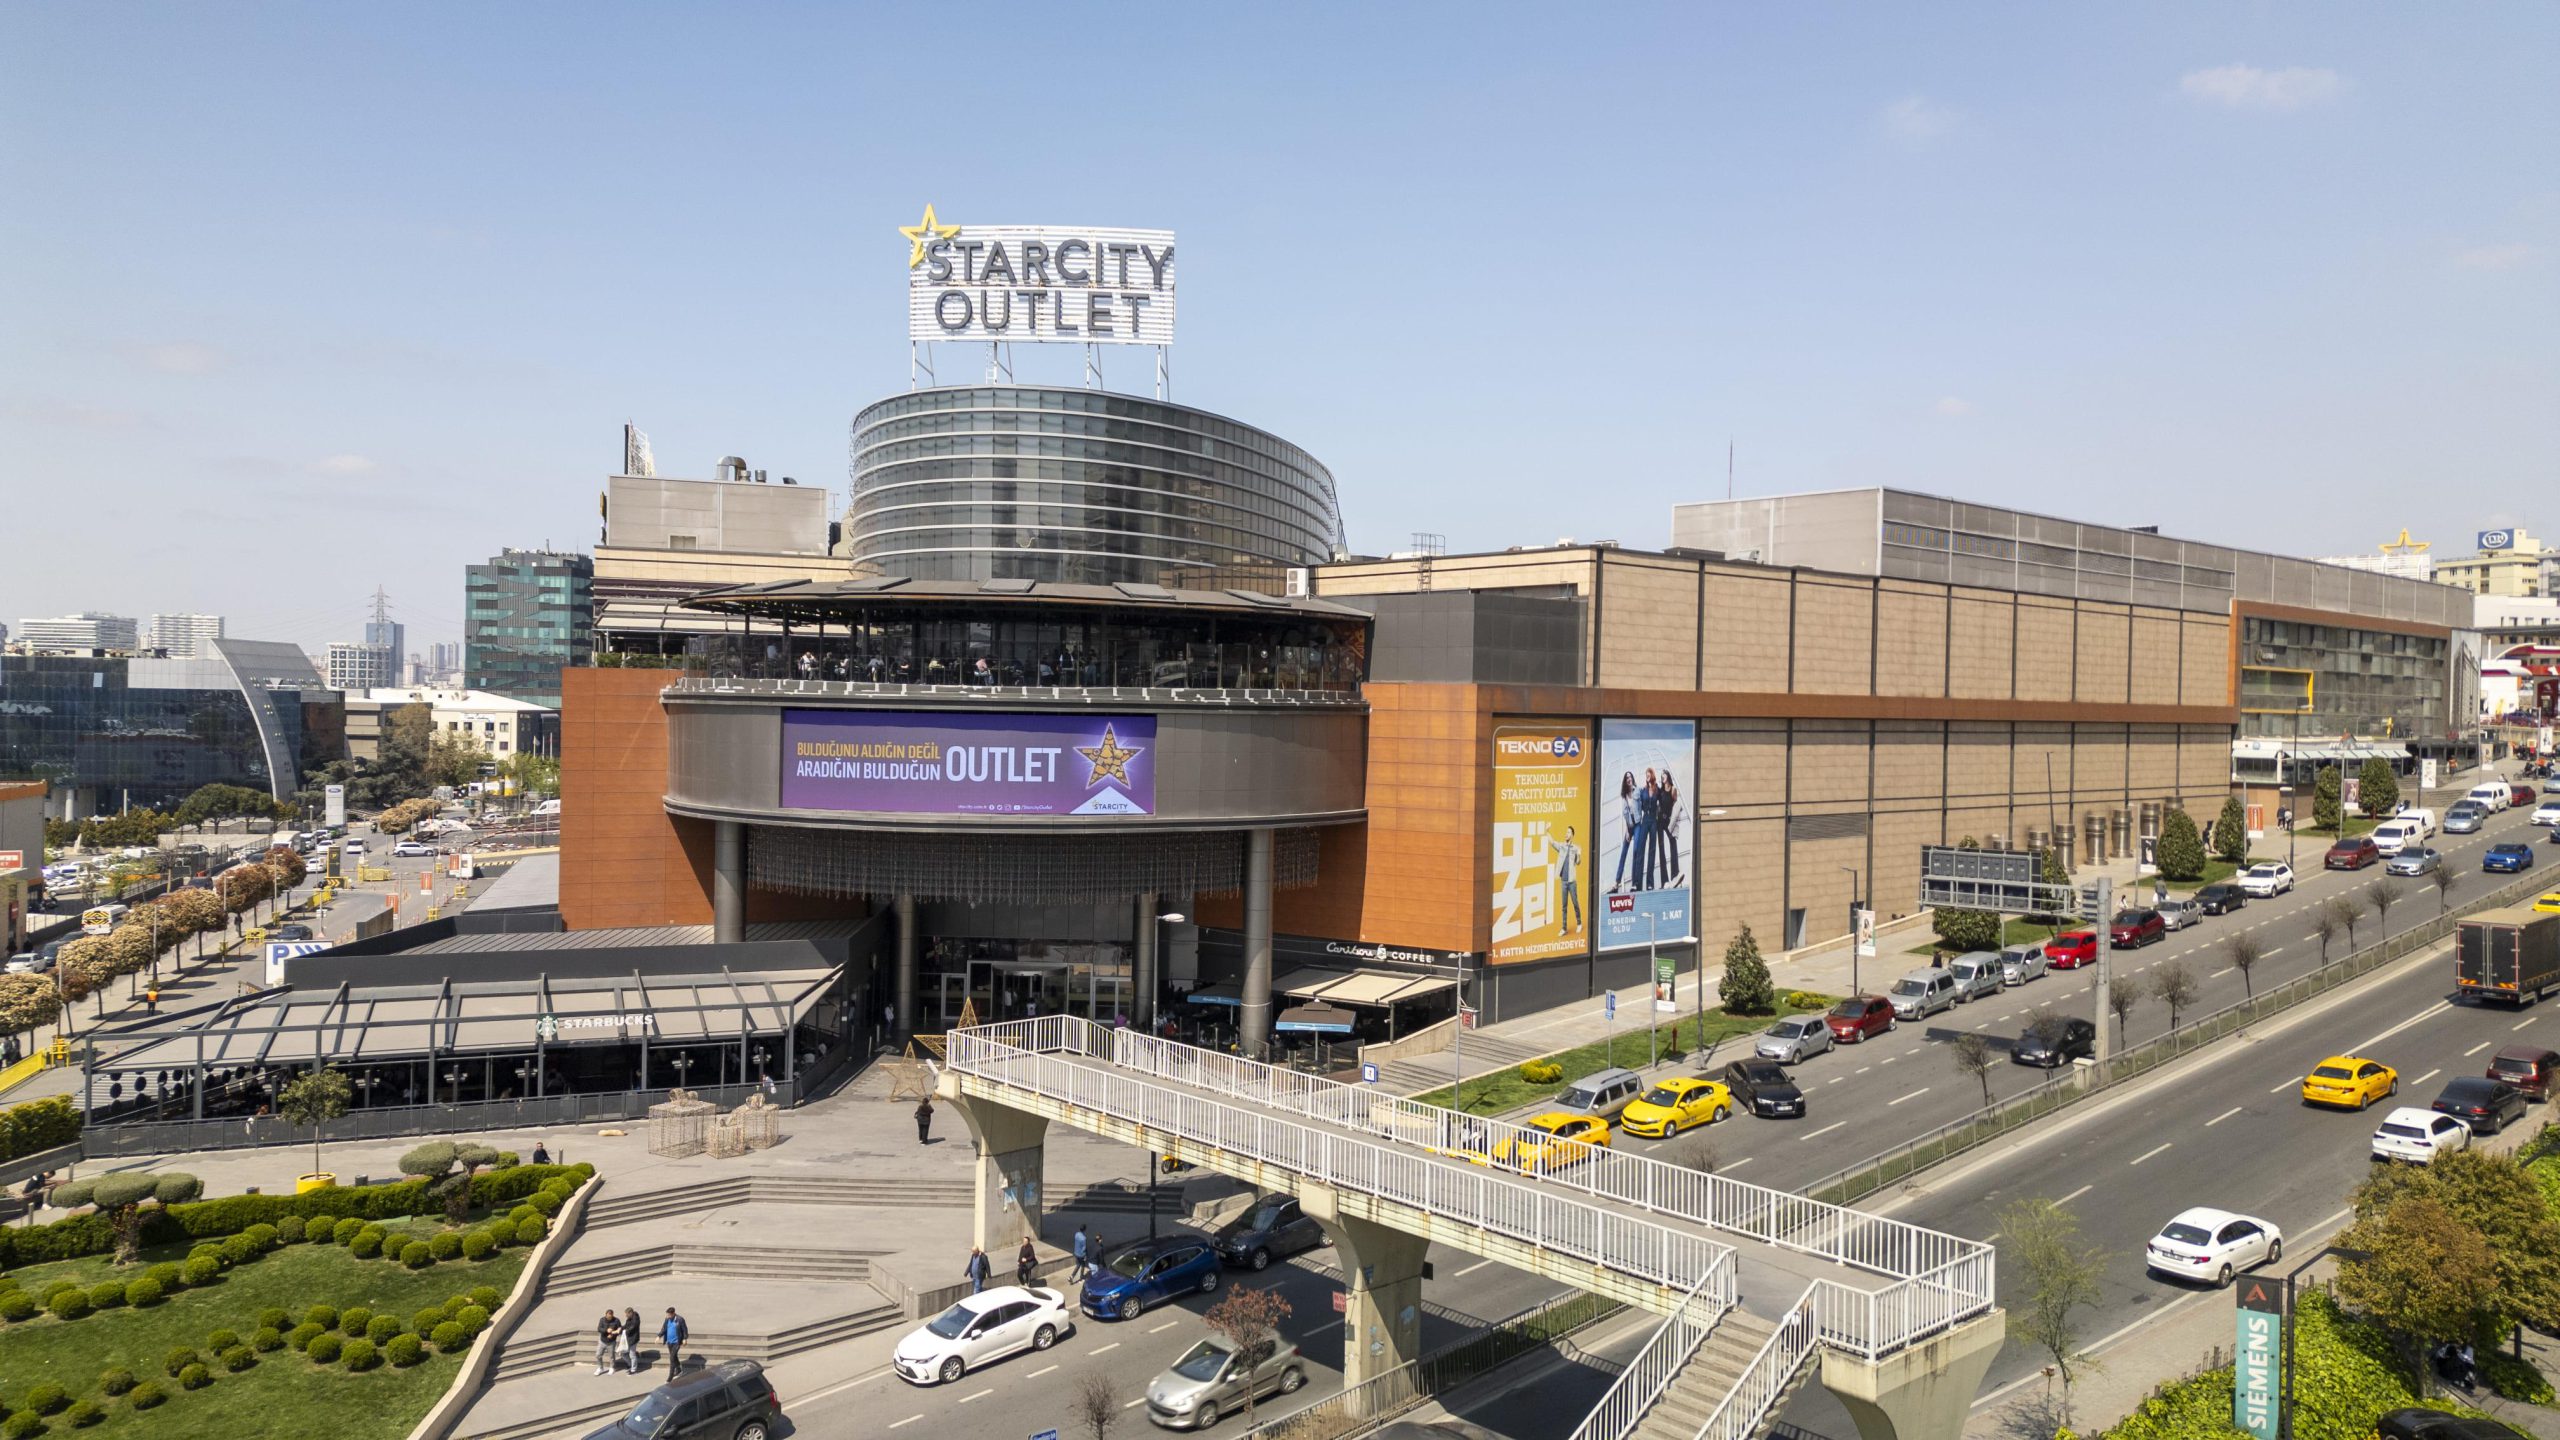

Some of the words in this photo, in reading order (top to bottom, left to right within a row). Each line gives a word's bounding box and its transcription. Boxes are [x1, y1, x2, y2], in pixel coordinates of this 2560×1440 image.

[926, 238, 1174, 286] STARCITY
[934, 289, 1150, 333] OUTLET
[797, 740, 859, 758] BULDUĞUNU
[861, 741, 905, 758] ALDIĞIN
[908, 742, 941, 759] DEĞİL
[1498, 740, 1580, 754] TEKNOSA
[796, 757, 860, 779] ARADIĞINI
[863, 759, 940, 780] BULDUĞUN
[946, 746, 1061, 782] OUTLET
[1501, 788, 1544, 801] STARCITY
[1546, 786, 1578, 798] OUTLET
[1094, 803, 1128, 811] STARCITY
[1669, 910, 1683, 920] KAT
[1612, 926, 1631, 934] OLDU
[273, 945, 290, 965] P
[1326, 941, 1374, 957] Caribou
[1391, 951, 1433, 963] COFFEE
[1500, 946, 1524, 958] KATTA
[564, 1014, 653, 1029] STARBUCKS
[2247, 1317, 2268, 1430] SIEMENS
